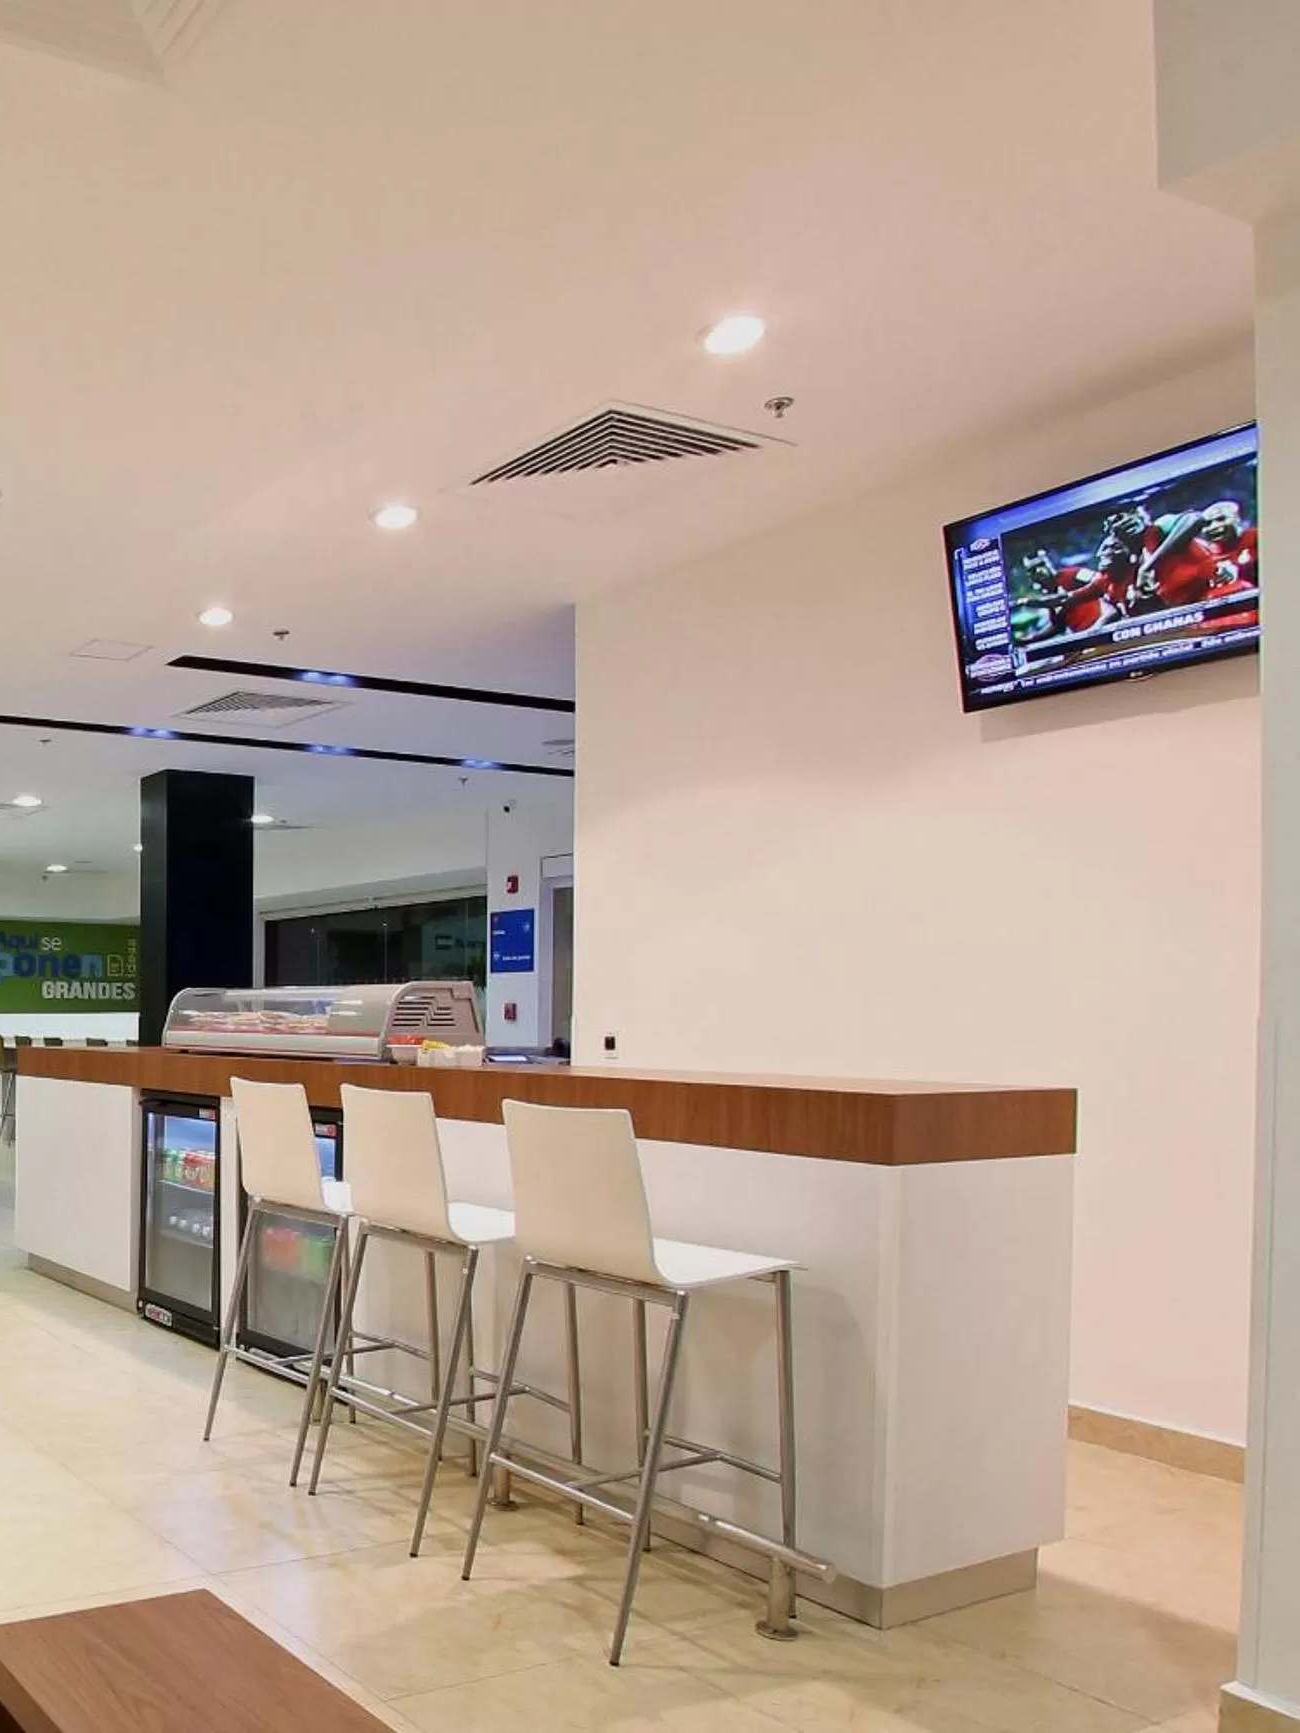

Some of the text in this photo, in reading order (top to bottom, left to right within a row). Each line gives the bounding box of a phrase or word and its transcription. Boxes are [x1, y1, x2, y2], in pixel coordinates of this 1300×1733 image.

[1112, 624, 1142, 643] CON
[41, 935, 63, 951] se
[41, 980, 136, 1000] GRANDES
